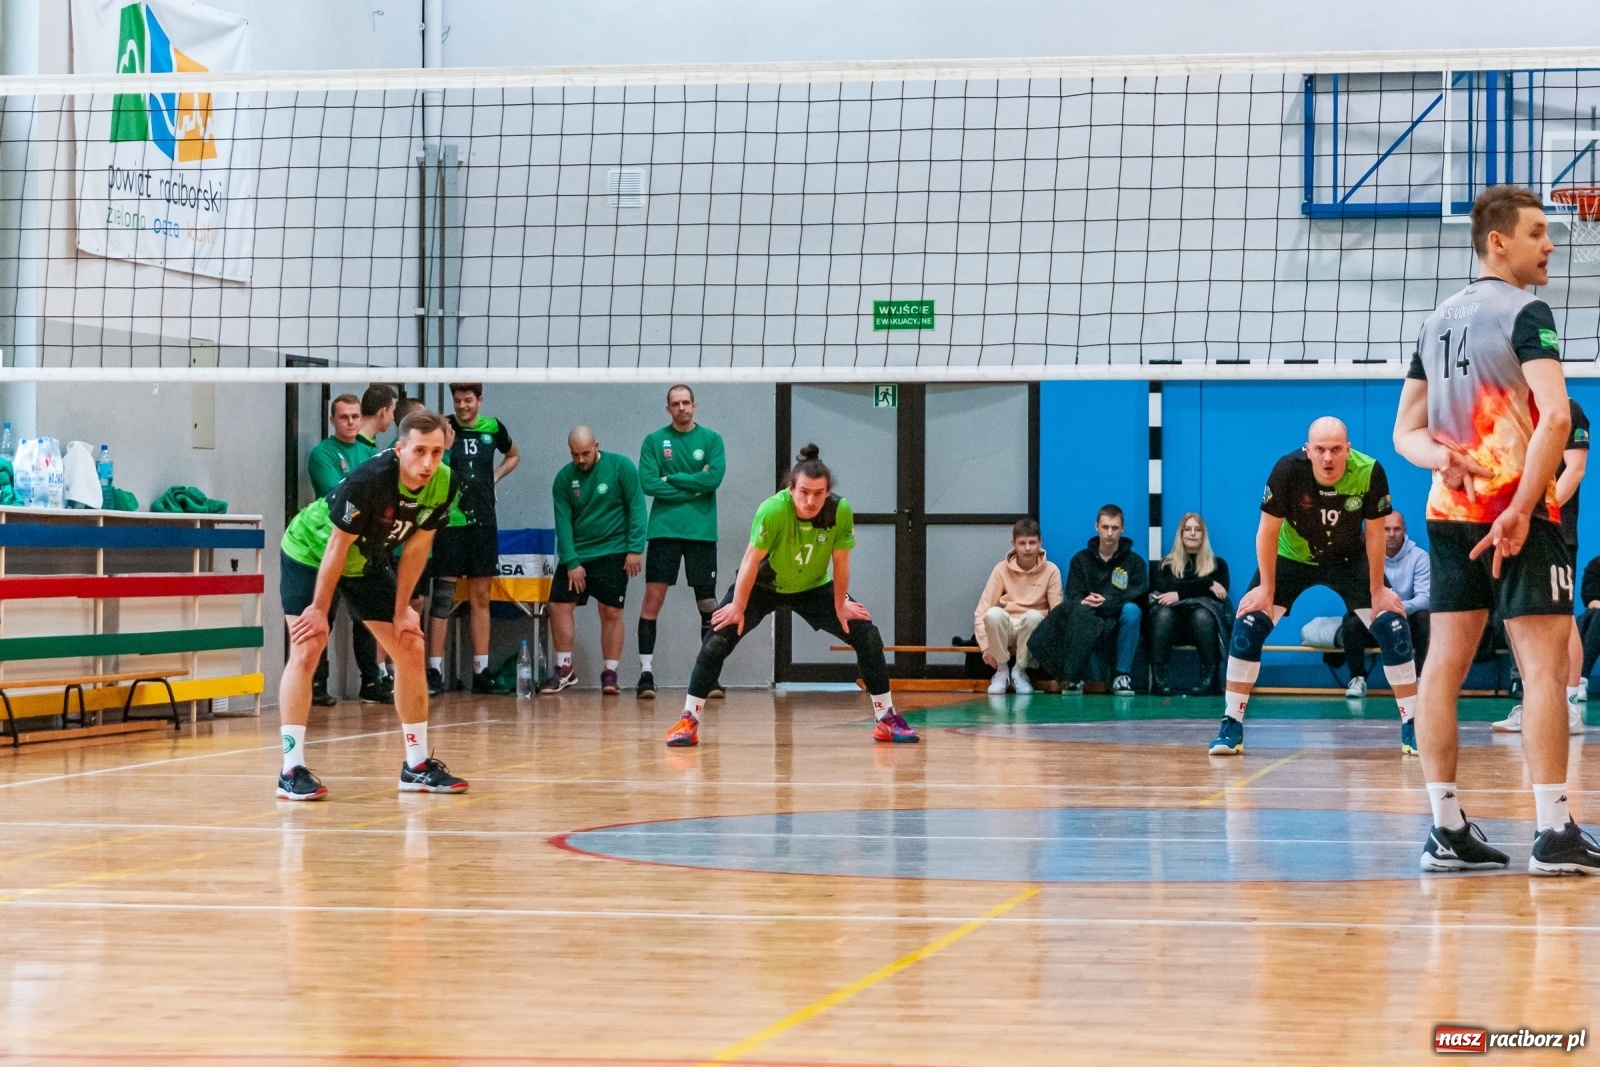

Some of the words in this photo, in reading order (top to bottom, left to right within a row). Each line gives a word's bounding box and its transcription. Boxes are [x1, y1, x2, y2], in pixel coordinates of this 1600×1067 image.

[108, 161, 151, 198] powiat
[160, 172, 222, 213] raciborski
[879, 304, 929, 315] WYJŚCIE
[876, 317, 932, 325] EWAKUACYJNE
[1439, 325, 1471, 379] 14
[463, 438, 478, 455] 13
[1320, 508, 1339, 526] 19
[794, 543, 814, 565] 47
[1550, 564, 1574, 601] 14
[406, 733, 417, 743] R
